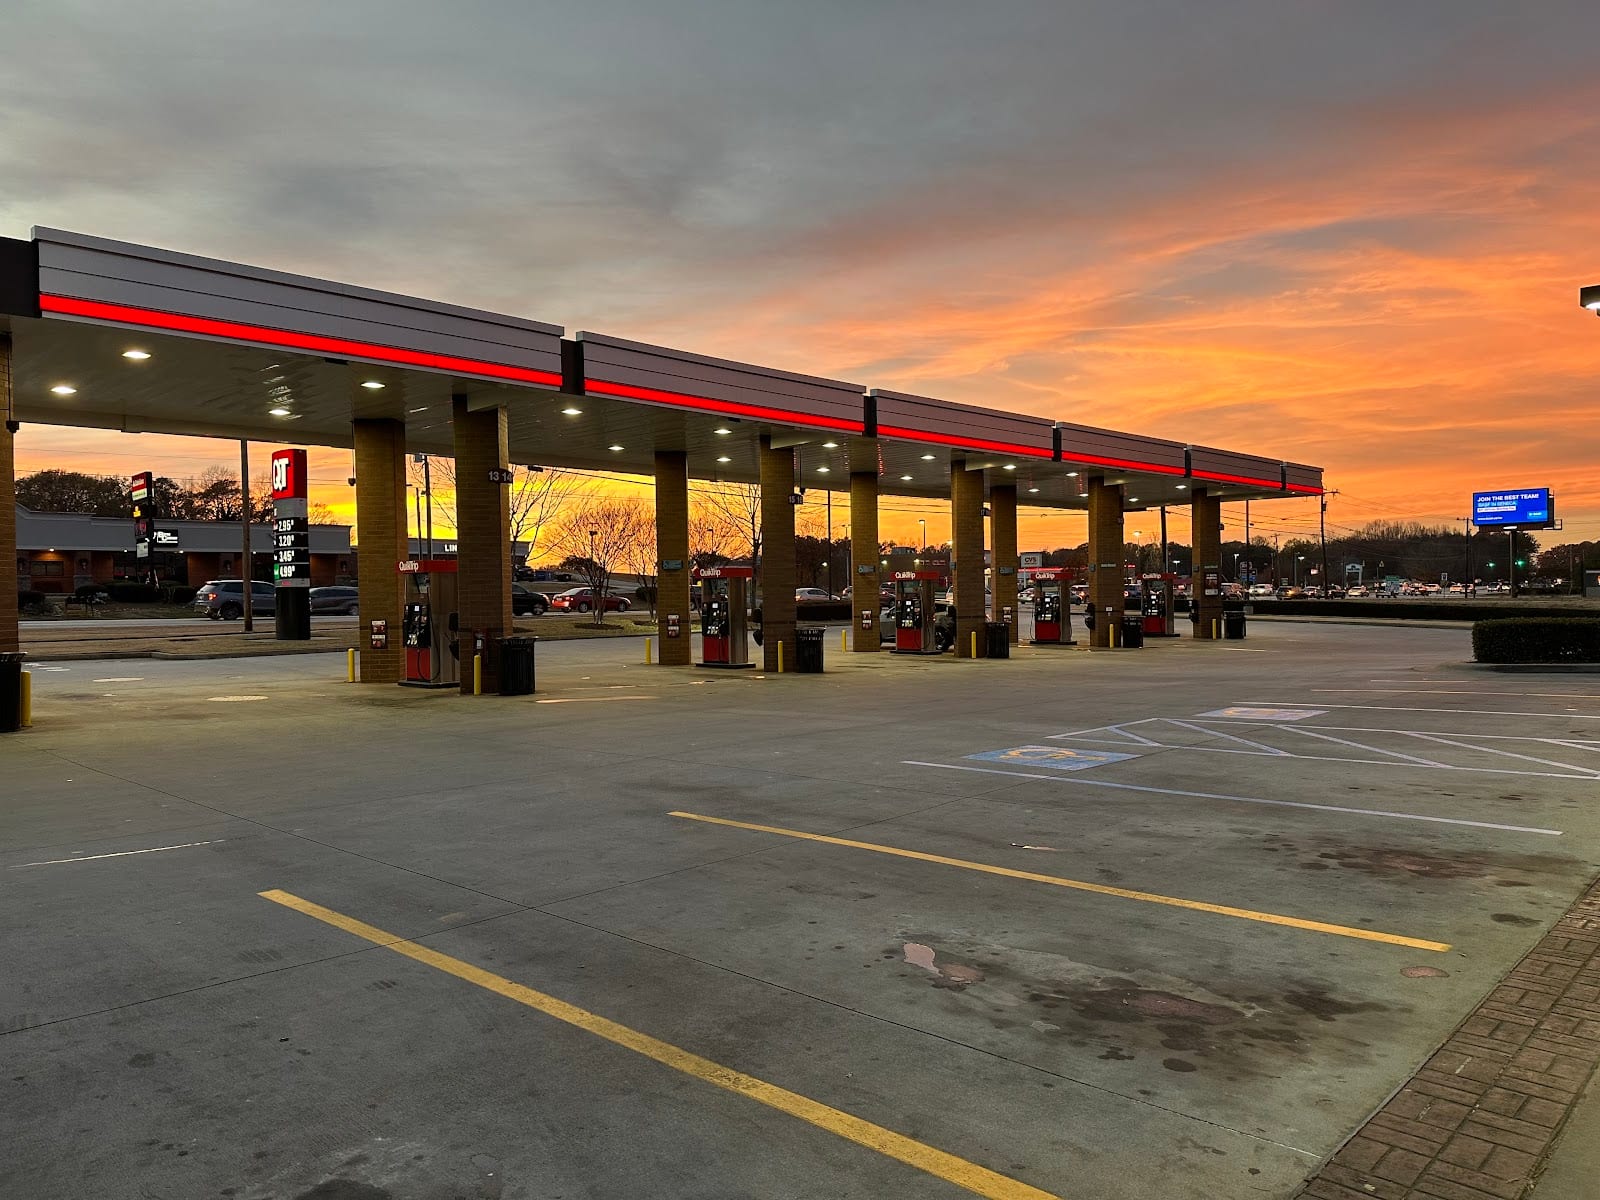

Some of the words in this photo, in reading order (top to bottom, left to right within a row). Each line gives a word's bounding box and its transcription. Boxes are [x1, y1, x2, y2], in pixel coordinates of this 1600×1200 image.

[273, 457, 289, 491] QT
[488, 471, 500, 481] 13
[502, 472, 512, 481] 14
[398, 560, 419, 572] QuikTrip
[700, 568, 721, 578] QuikTrip
[895, 571, 916, 580] QuikTrip
